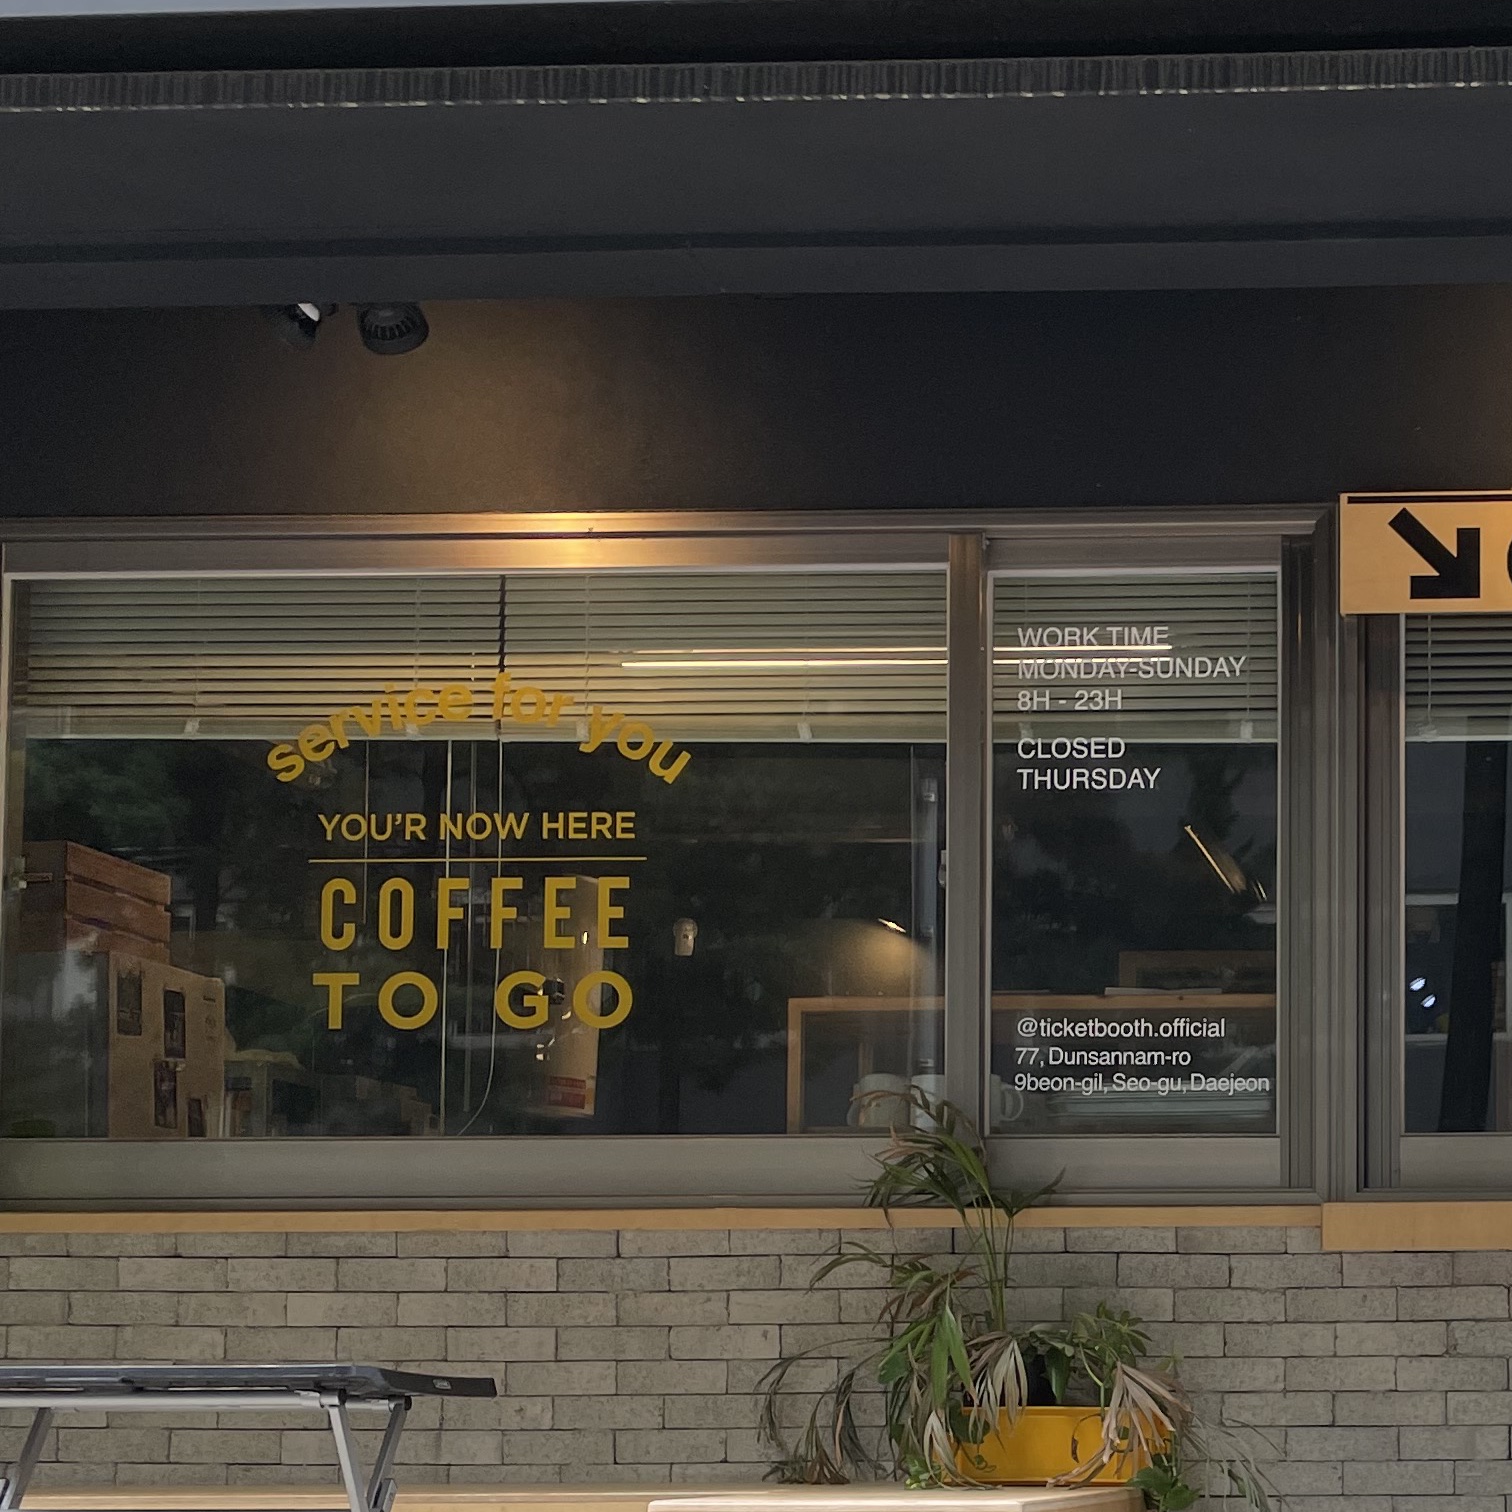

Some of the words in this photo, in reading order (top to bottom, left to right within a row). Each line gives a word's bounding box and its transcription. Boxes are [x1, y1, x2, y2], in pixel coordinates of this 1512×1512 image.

[1017, 626, 1100, 647] WORK
[1106, 625, 1169, 647] TIME
[1018, 655, 1247, 680] MONDAY-SUNDAY
[1017, 689, 1050, 711] 8H
[1074, 688, 1123, 711] 23H
[267, 682, 474, 782] service
[492, 671, 576, 728] for
[579, 704, 692, 785] you
[1017, 737, 1126, 760] CLOSED
[1017, 767, 1162, 790] THURSDAY
[318, 812, 427, 841] YOU'R
[439, 812, 530, 840] NOW
[542, 811, 636, 839] HERE
[320, 876, 631, 951] COFFEE
[312, 970, 439, 1031] TO
[495, 969, 634, 1030] GO
[1017, 1017, 1226, 1038] @ticketbooth.official
[1015, 1047, 1044, 1068] 77,
[1049, 1046, 1192, 1066] Dunsannam-ro
[1014, 1073, 1108, 1096] 9beon-gil,
[1112, 1073, 1188, 1096] Seo-gu,
[1190, 1073, 1270, 1096] Daejeon
